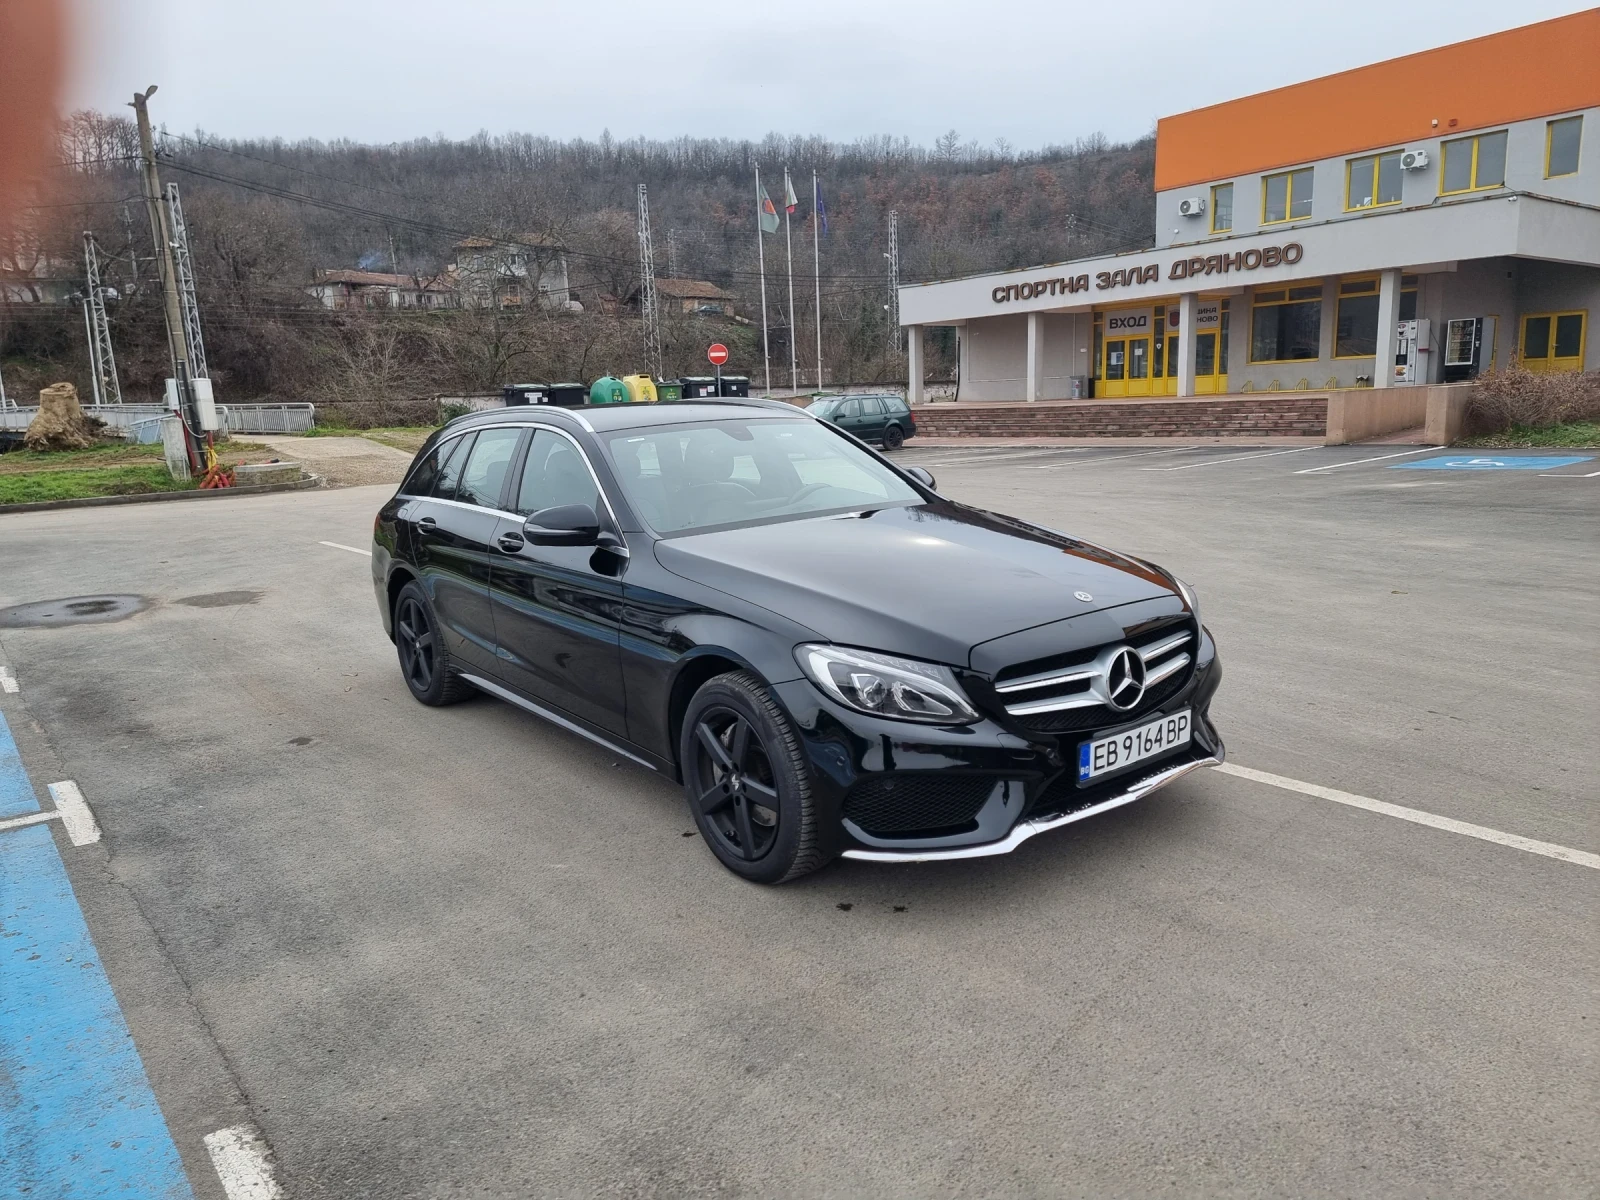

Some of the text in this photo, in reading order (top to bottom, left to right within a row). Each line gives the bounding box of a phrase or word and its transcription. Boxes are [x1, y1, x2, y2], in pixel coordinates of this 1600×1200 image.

[991, 242, 1304, 303] СПОРТНА ЗАЛА ДРЯНОВО
[1109, 315, 1147, 329] ВХОД
[1196, 315, 1219, 323] НОВО
[1093, 715, 1188, 771] EB 9164 BP
[1080, 766, 1090, 775] BG
